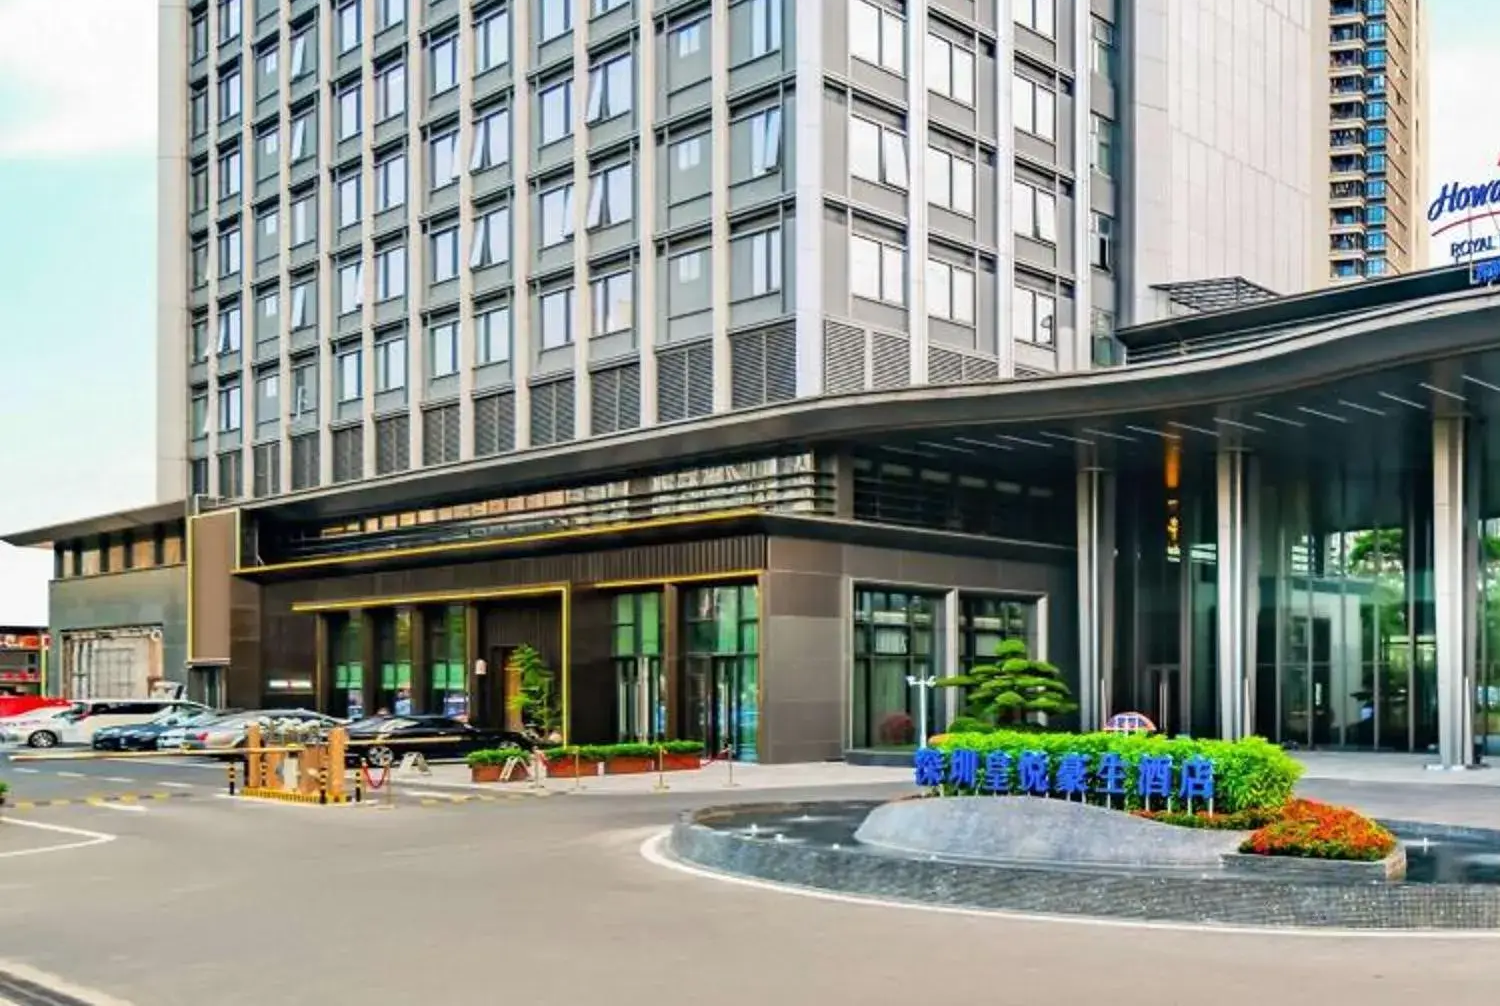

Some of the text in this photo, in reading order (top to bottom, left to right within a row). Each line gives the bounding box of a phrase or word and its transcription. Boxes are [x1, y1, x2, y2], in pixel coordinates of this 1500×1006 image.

[1450, 235, 1495, 258] ROYAL
[914, 747, 1214, 798] 深圳皇悦豪生酒店
